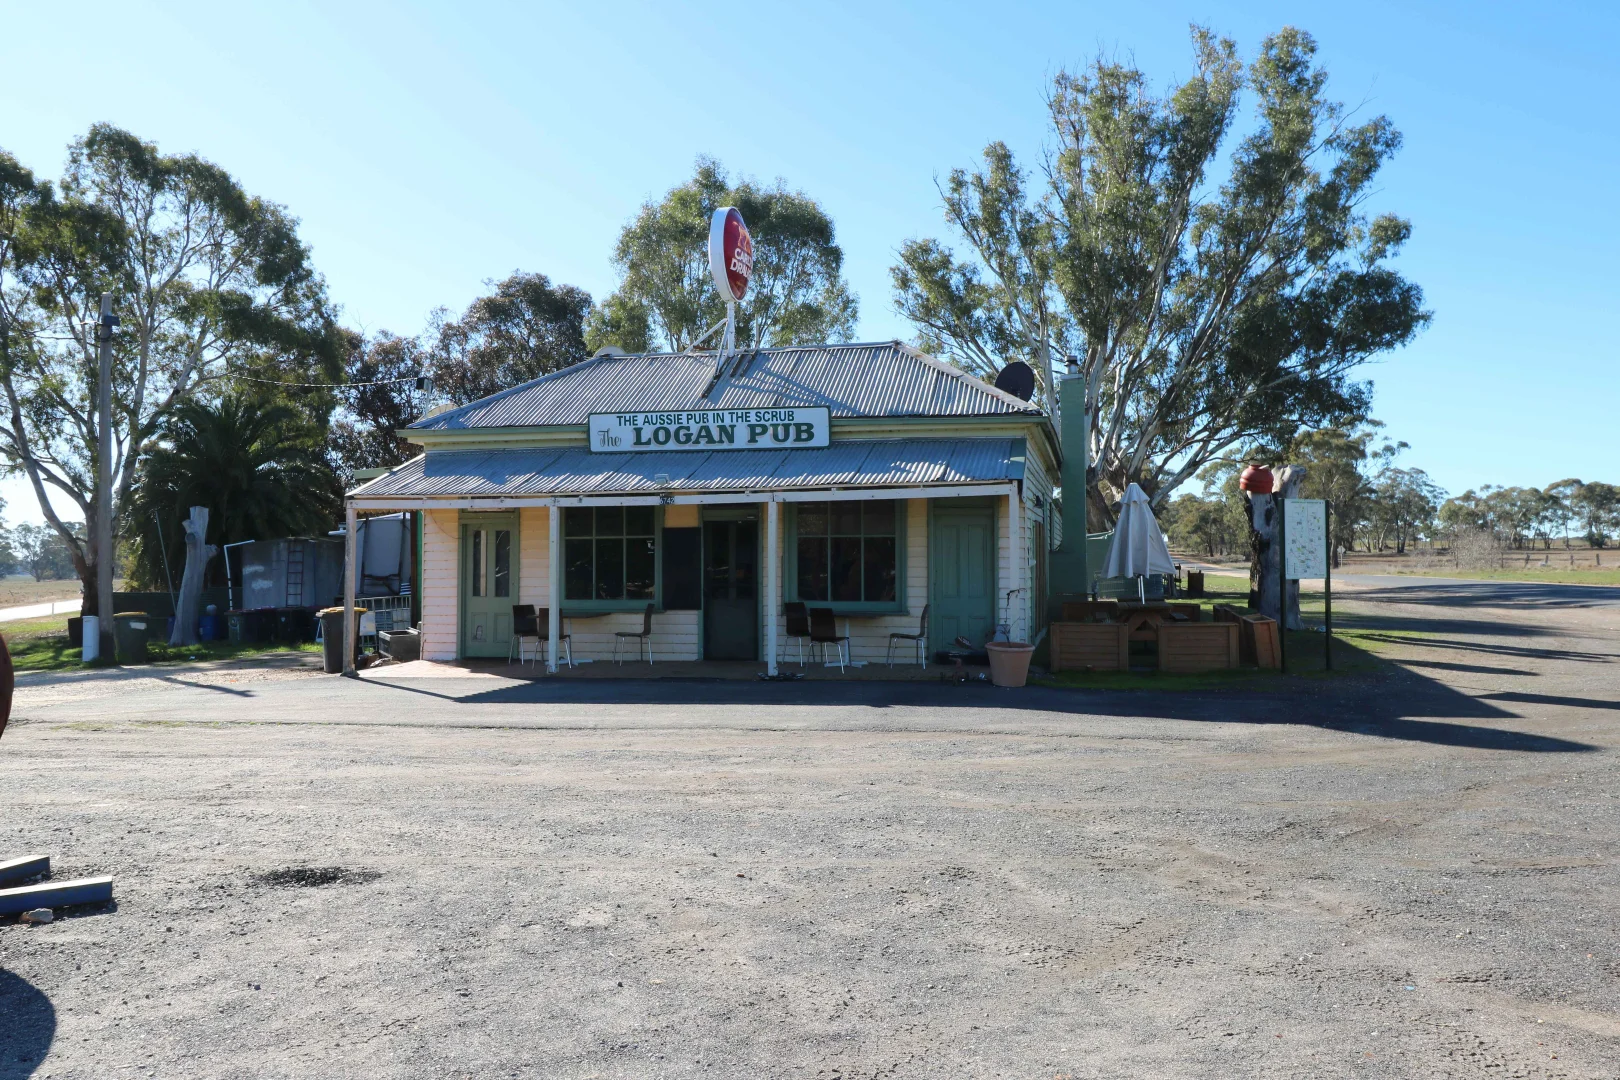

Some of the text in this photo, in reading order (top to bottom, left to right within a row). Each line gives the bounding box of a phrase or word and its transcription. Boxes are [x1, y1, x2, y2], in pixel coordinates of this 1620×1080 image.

[616, 410, 794, 426] THE AUSSIE PUB IN THE SCRUB
[597, 422, 815, 447] The LOGAN PUB
